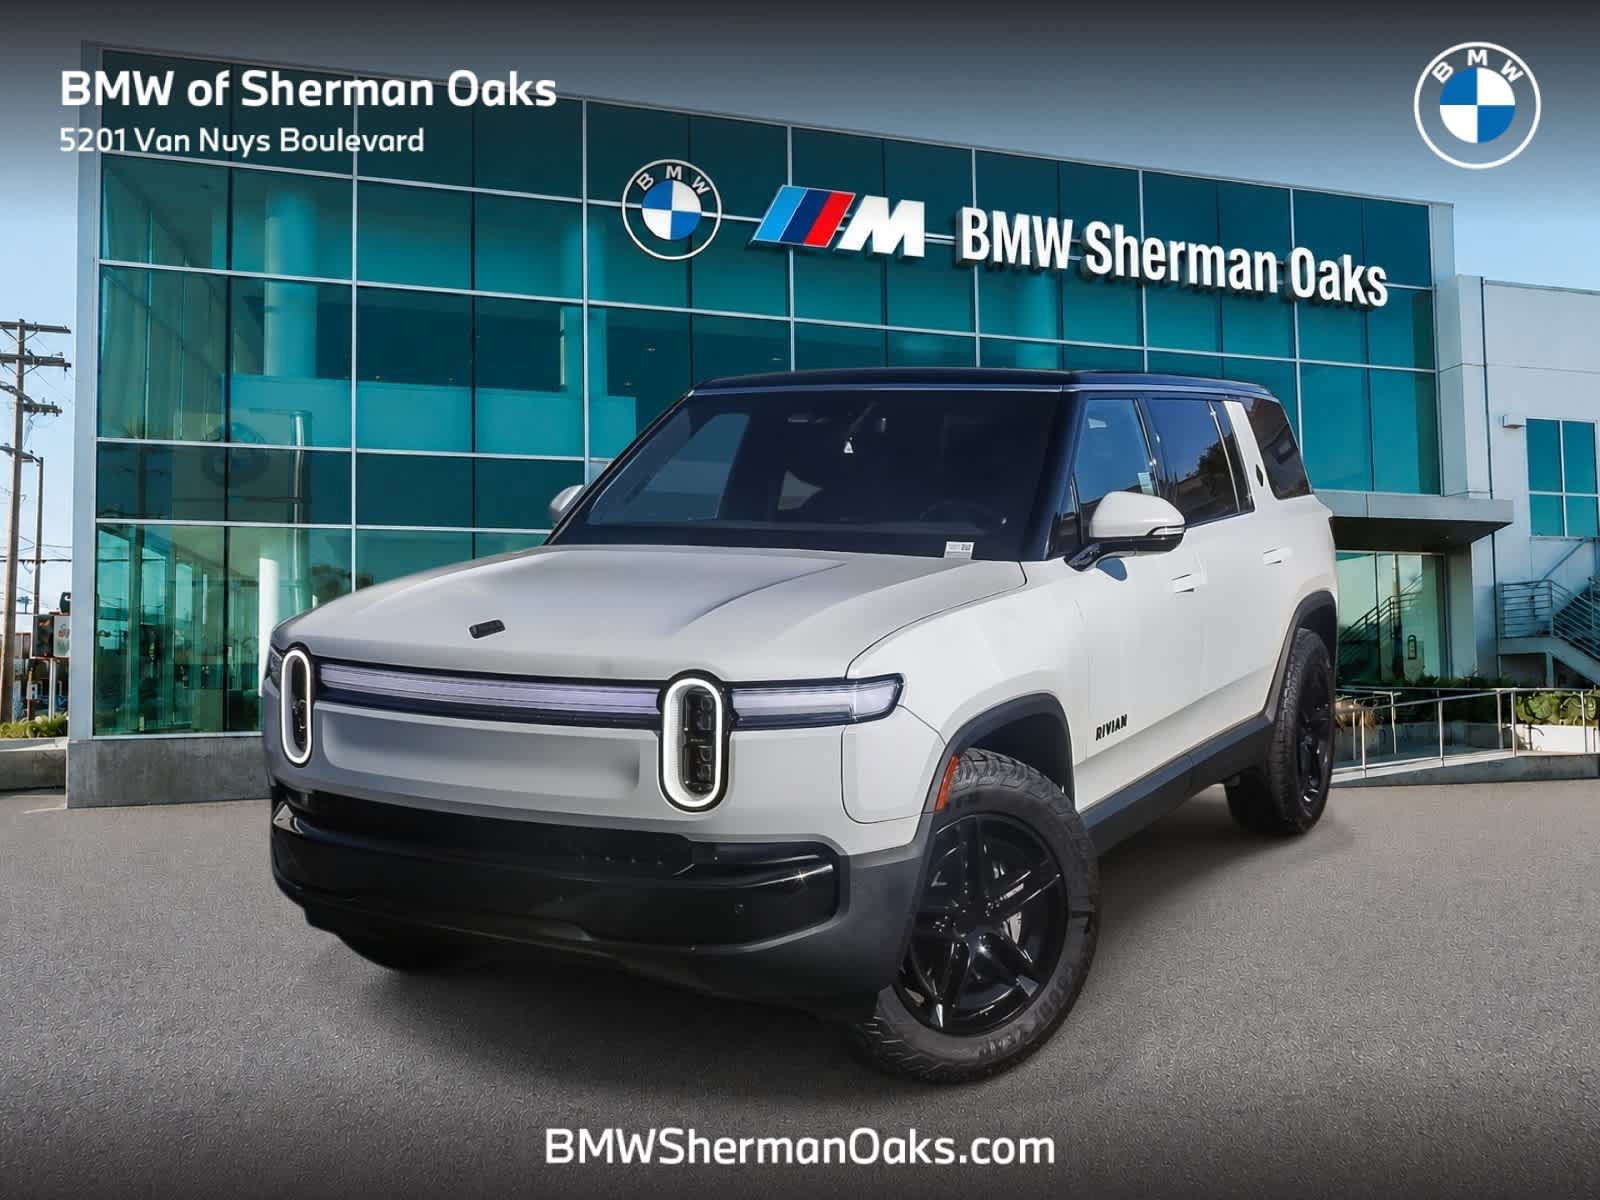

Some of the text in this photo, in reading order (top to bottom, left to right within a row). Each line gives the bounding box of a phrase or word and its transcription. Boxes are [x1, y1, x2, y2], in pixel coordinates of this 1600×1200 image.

[636, 165, 711, 195] BMW
[959, 206, 1389, 308] BMW Sherman Oaks
[1095, 713, 1128, 741] RIVIAN
